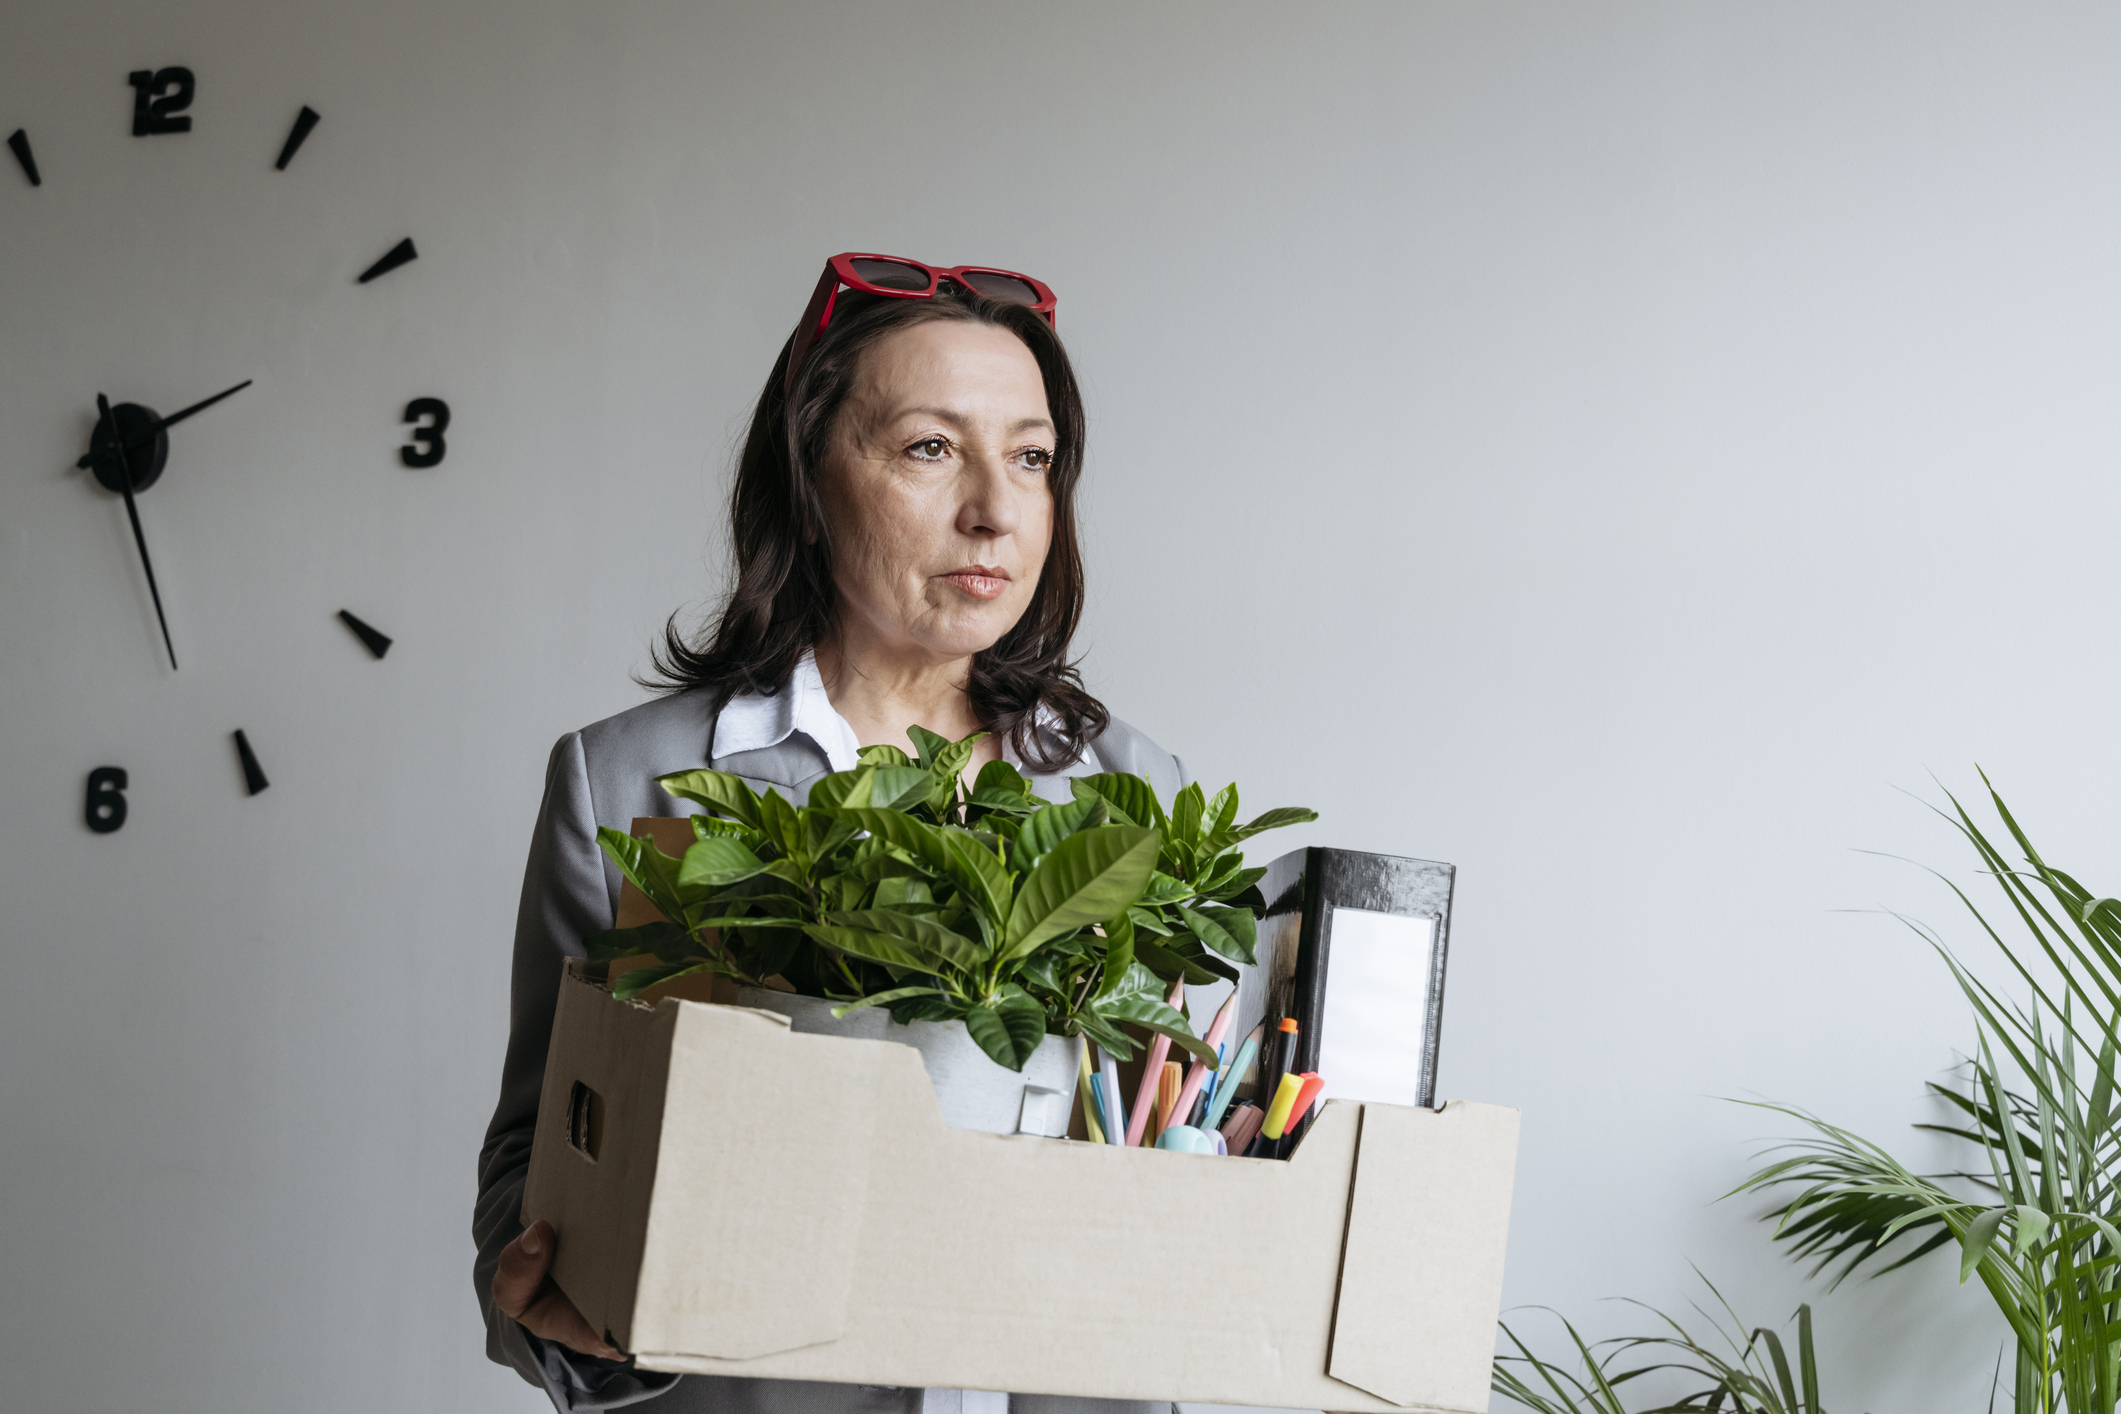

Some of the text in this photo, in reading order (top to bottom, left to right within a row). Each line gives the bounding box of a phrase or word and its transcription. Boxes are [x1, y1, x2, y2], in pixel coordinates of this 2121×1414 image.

[127, 66, 196, 138] 12
[400, 398, 450, 468] 3
[84, 766, 127, 834] 6
